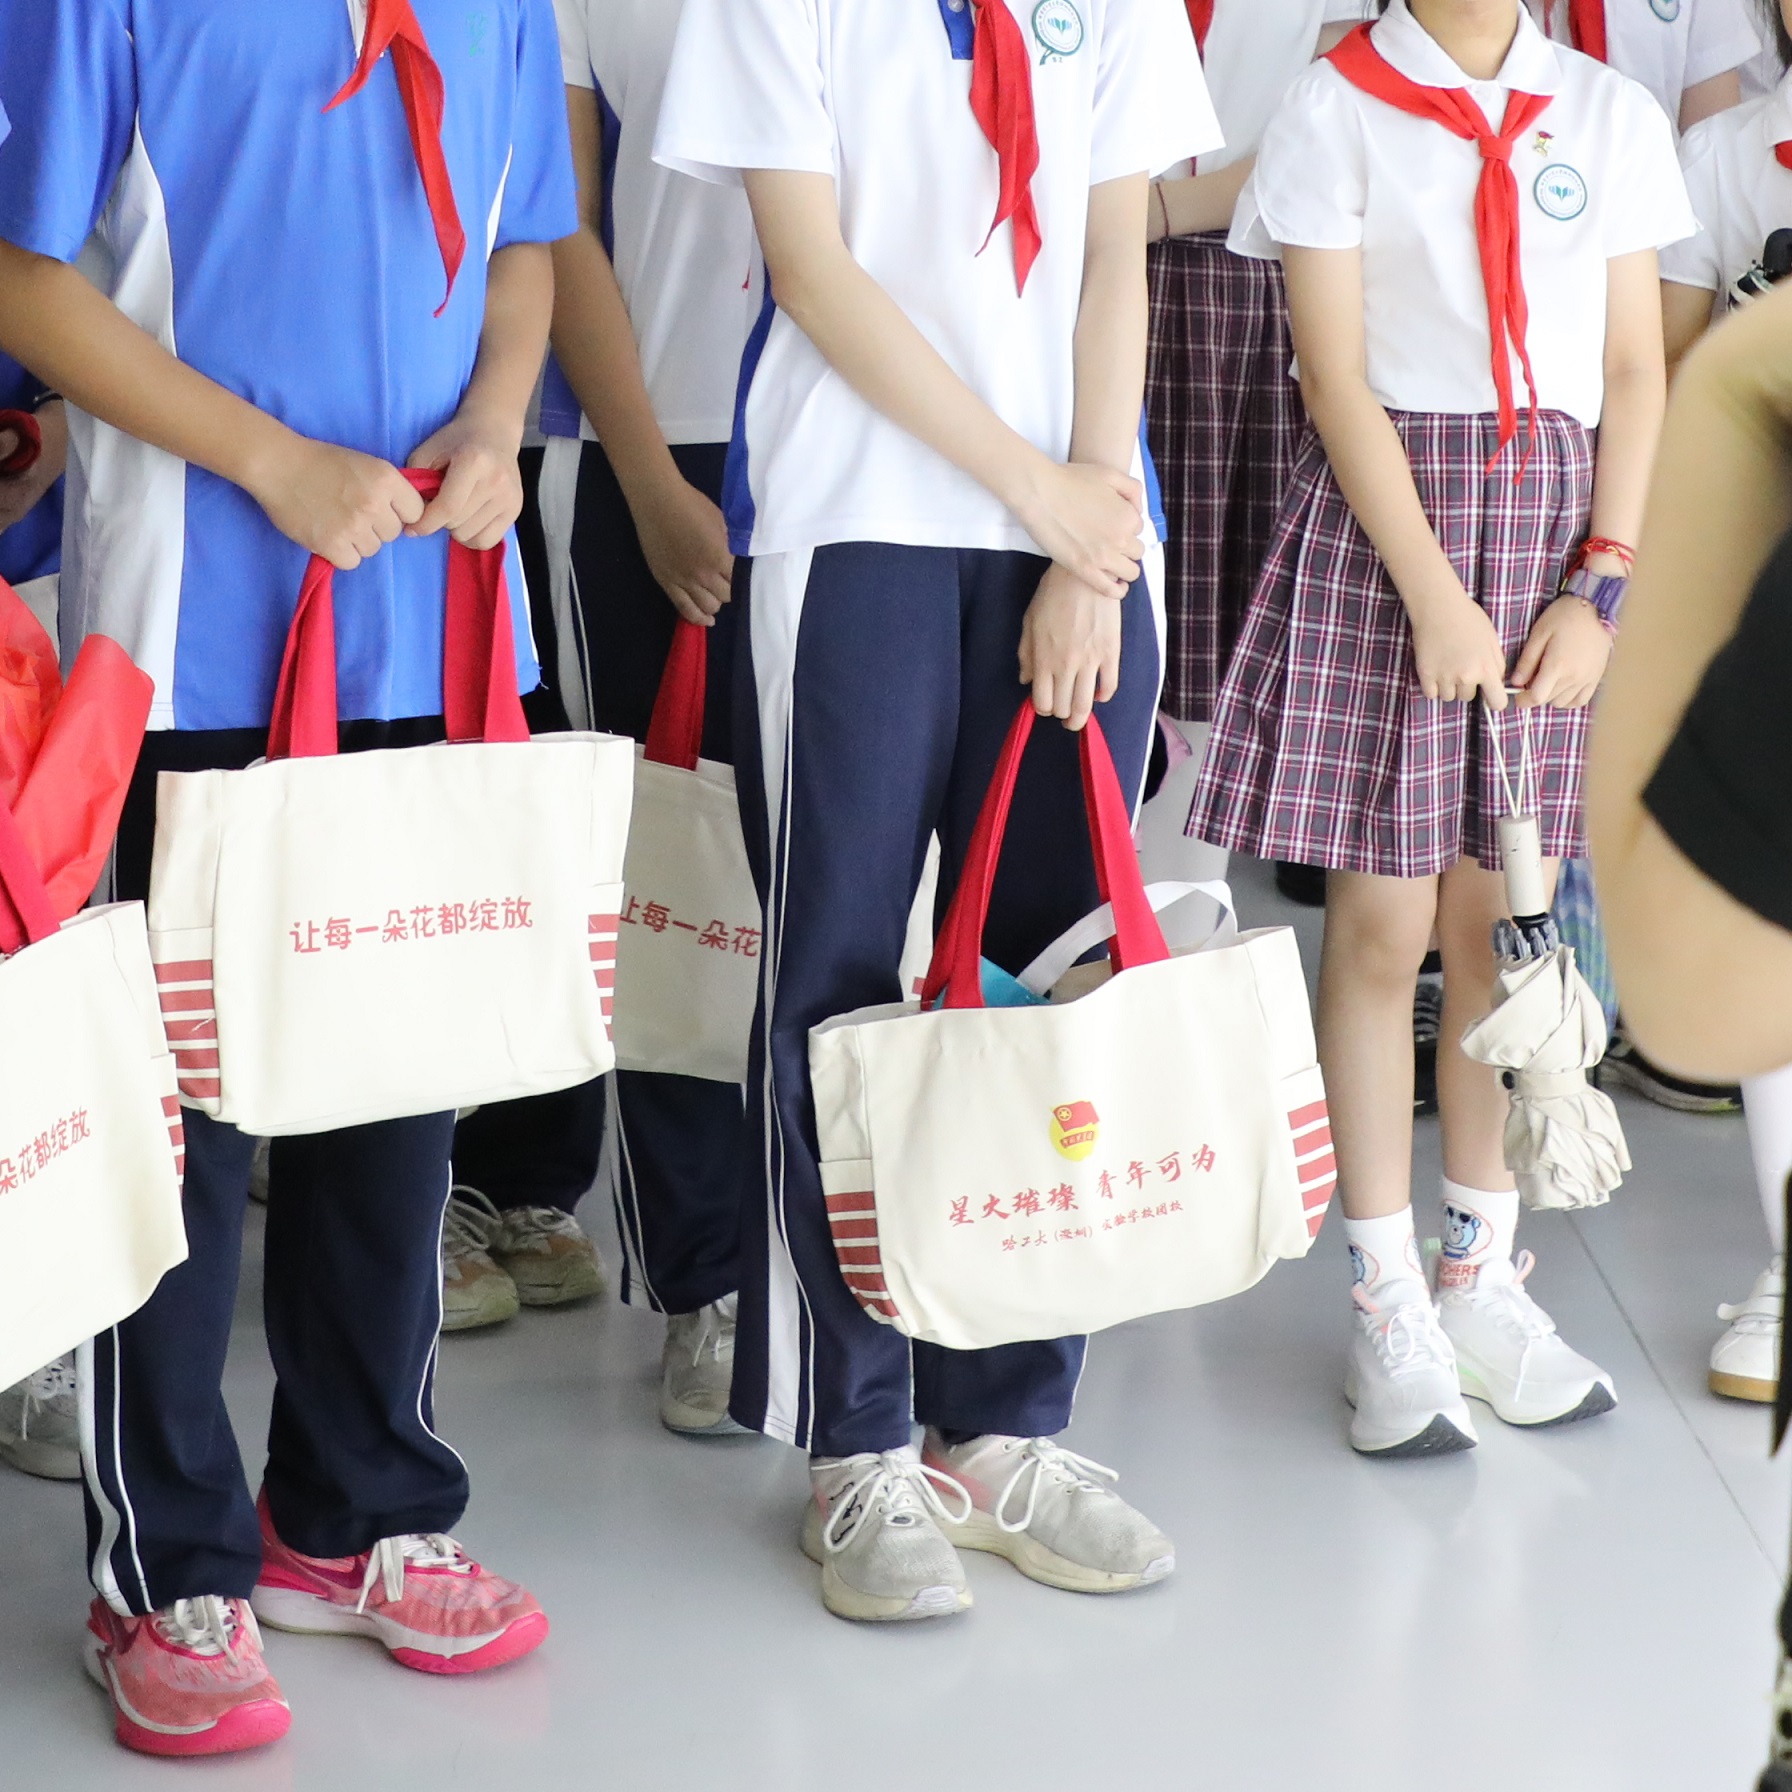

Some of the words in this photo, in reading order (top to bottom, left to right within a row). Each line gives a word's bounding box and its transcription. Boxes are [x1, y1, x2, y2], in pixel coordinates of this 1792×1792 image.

[289, 896, 533, 955] 让每一朵花都绽放
[948, 1182, 1080, 1227] 星火璀璨
[1096, 1143, 1216, 1200] 青年可为
